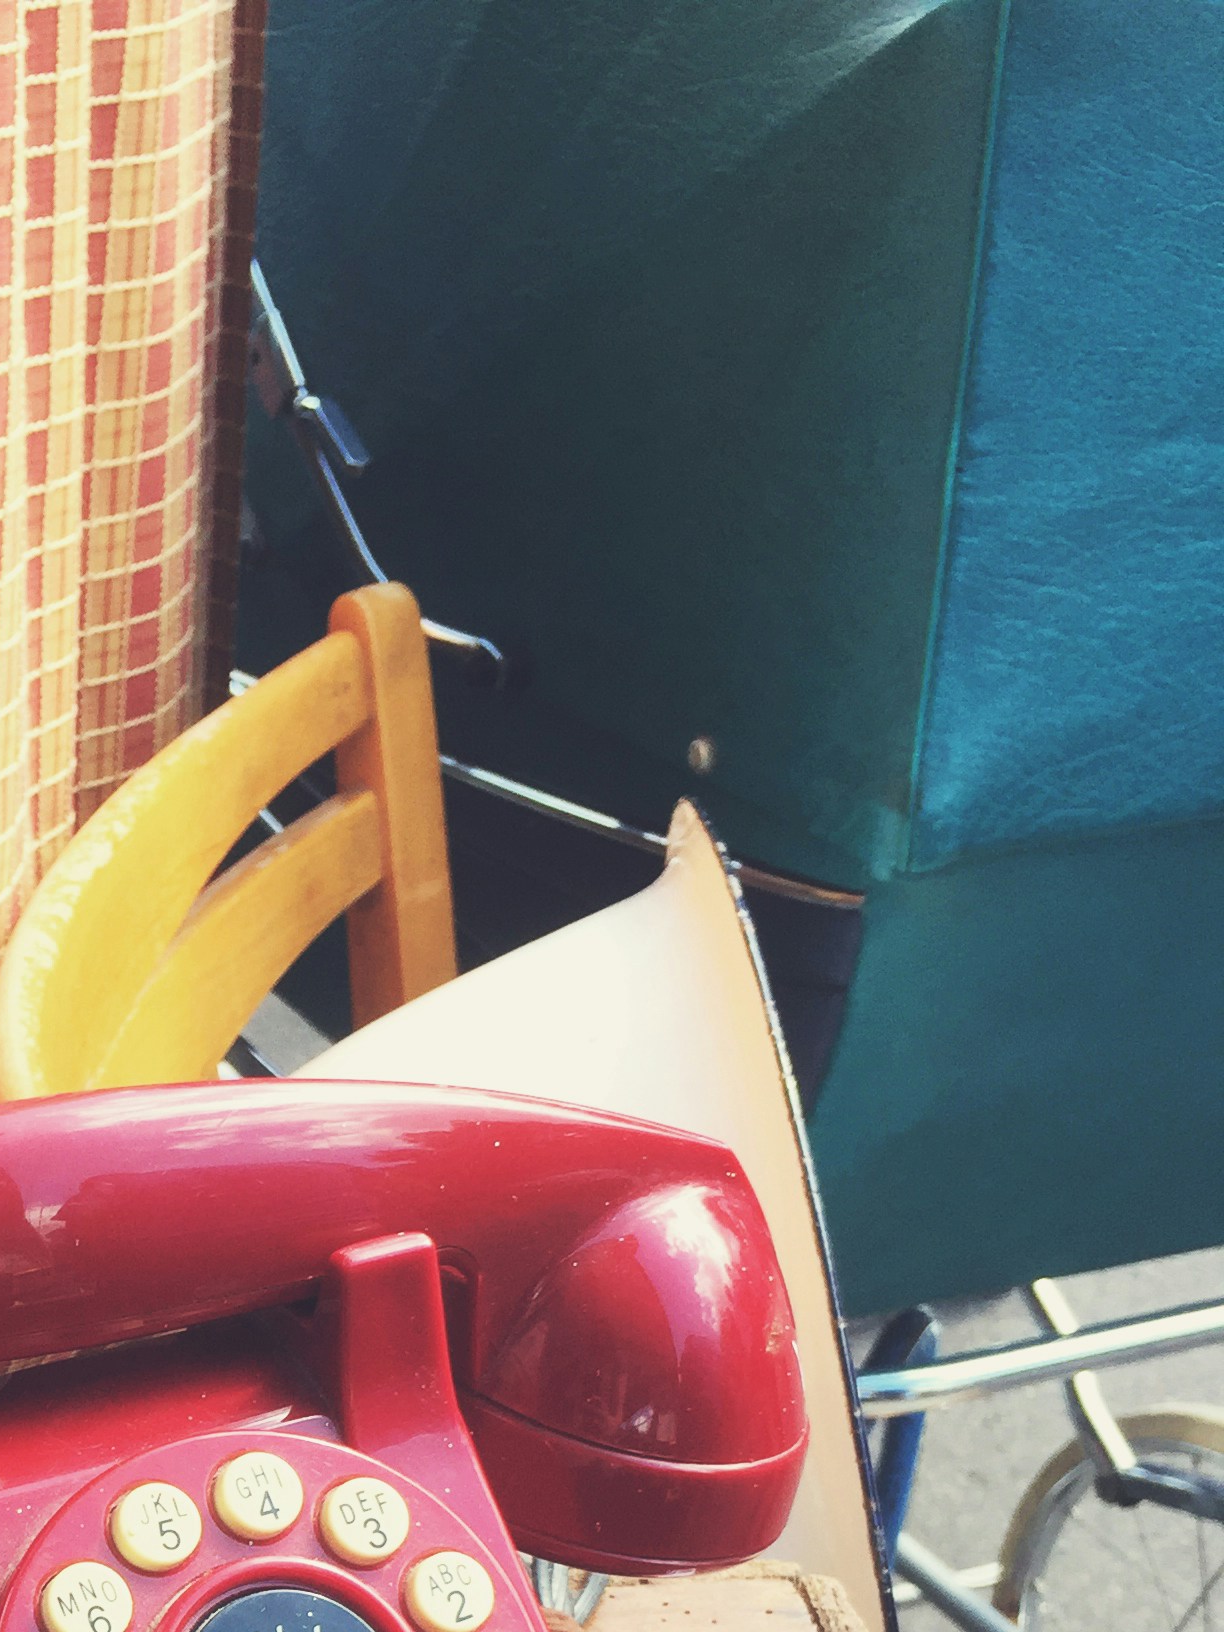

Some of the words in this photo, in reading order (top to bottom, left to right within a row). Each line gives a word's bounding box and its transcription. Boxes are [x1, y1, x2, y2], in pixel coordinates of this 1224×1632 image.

[235, 1464, 283, 1499] GHI
[140, 1493, 187, 1525] JKL
[259, 1490, 280, 1520] 4
[339, 1490, 386, 1525] DEF
[158, 1518, 181, 1550] 5
[363, 1518, 387, 1548] 3
[429, 1563, 472, 1596] ABC
[57, 1579, 117, 1617] MNO
[447, 1590, 474, 1622] 2
